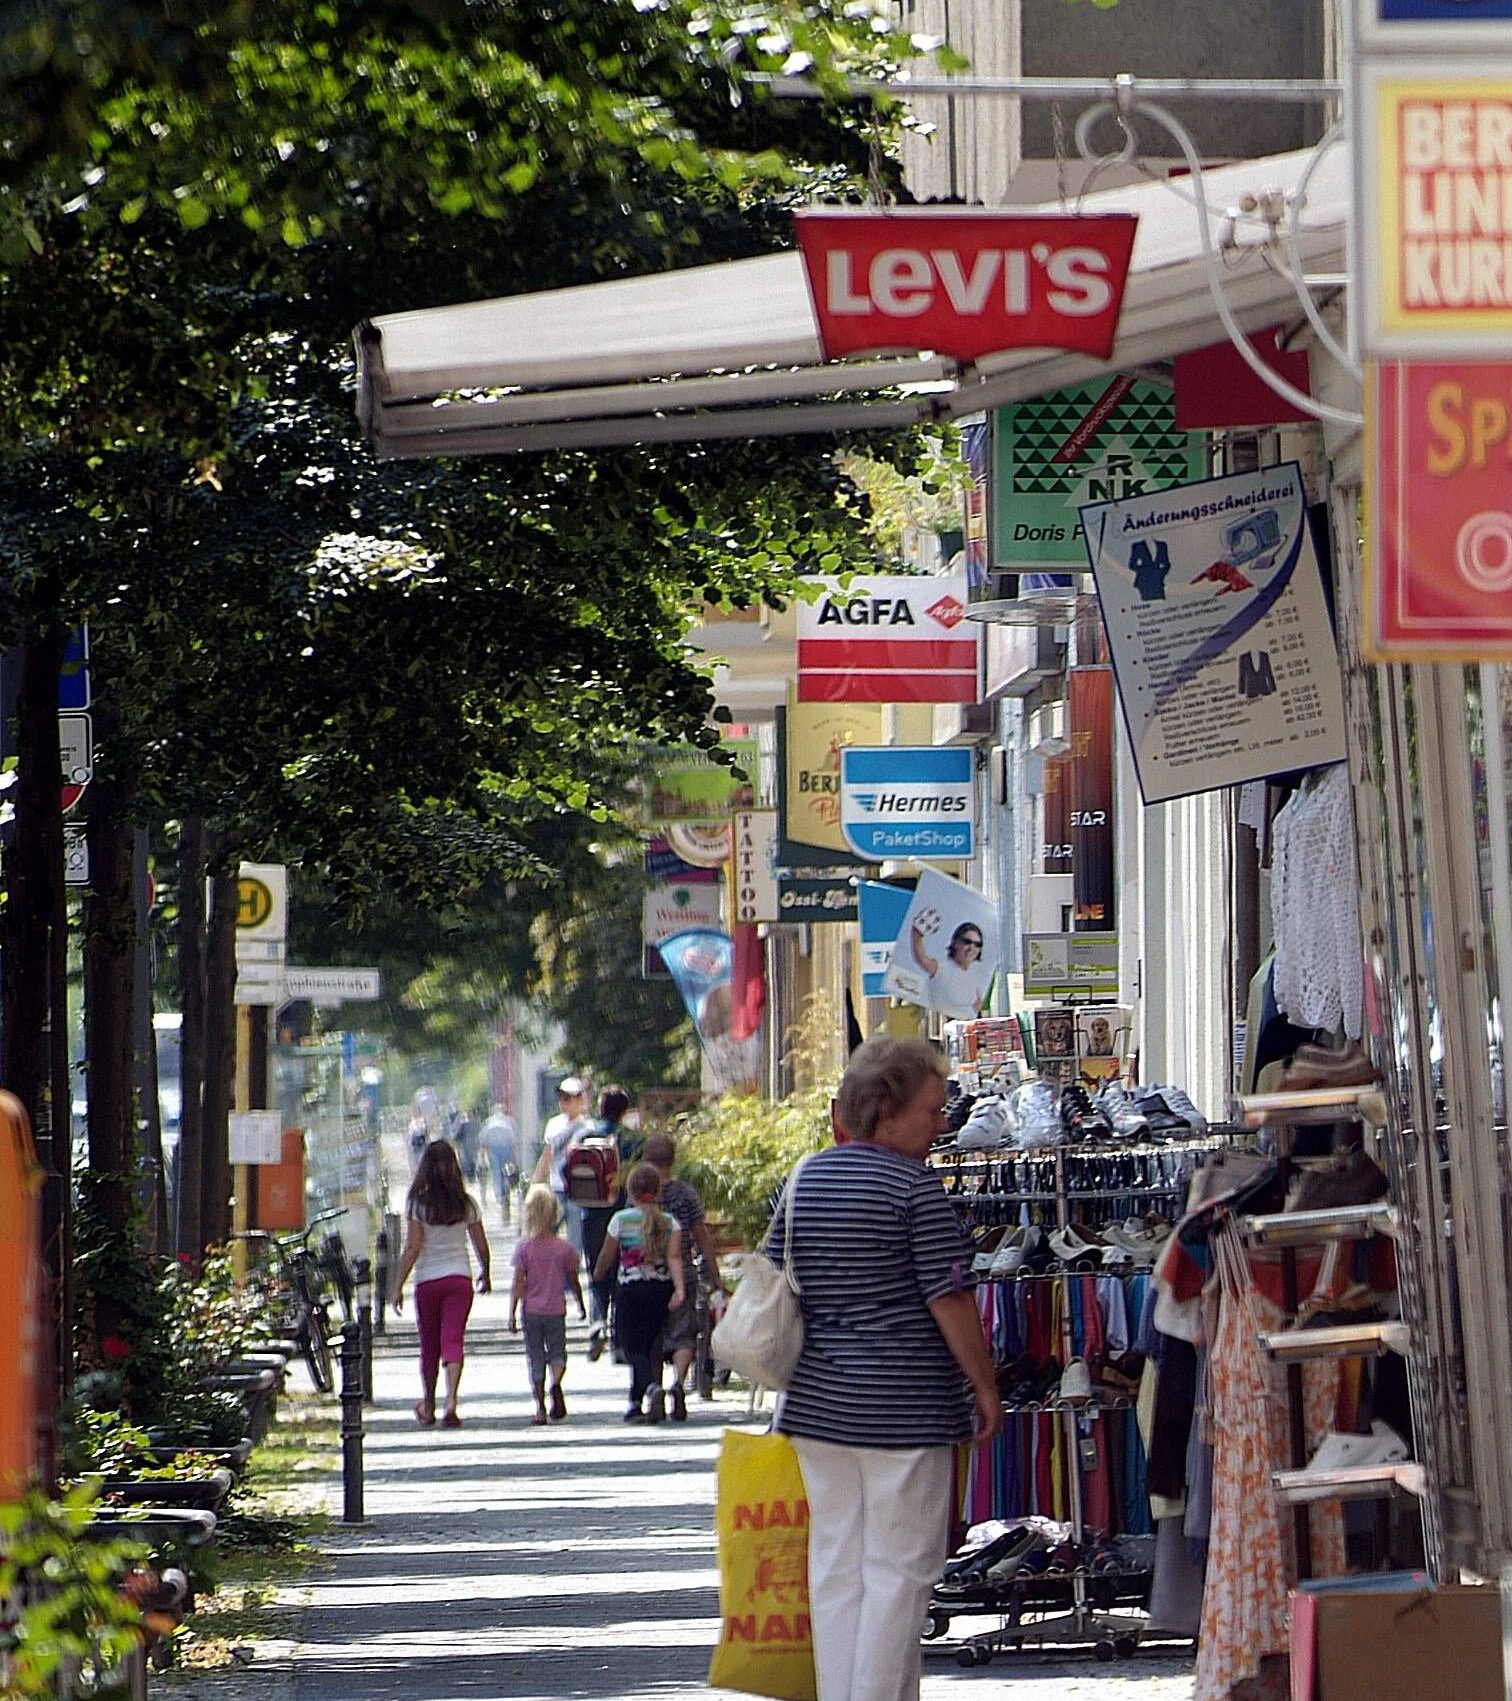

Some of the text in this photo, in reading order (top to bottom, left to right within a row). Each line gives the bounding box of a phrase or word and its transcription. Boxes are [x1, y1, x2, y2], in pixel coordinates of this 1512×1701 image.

[1122, 482, 1295, 533] Änderungsschneiderei
[1013, 523, 1066, 541] Doris
[817, 598, 915, 626] AGFA
[878, 793, 967, 812] Hermes
[872, 829, 965, 849] PaketShop
[739, 814, 756, 919] TATTOO
[238, 890, 259, 916] H
